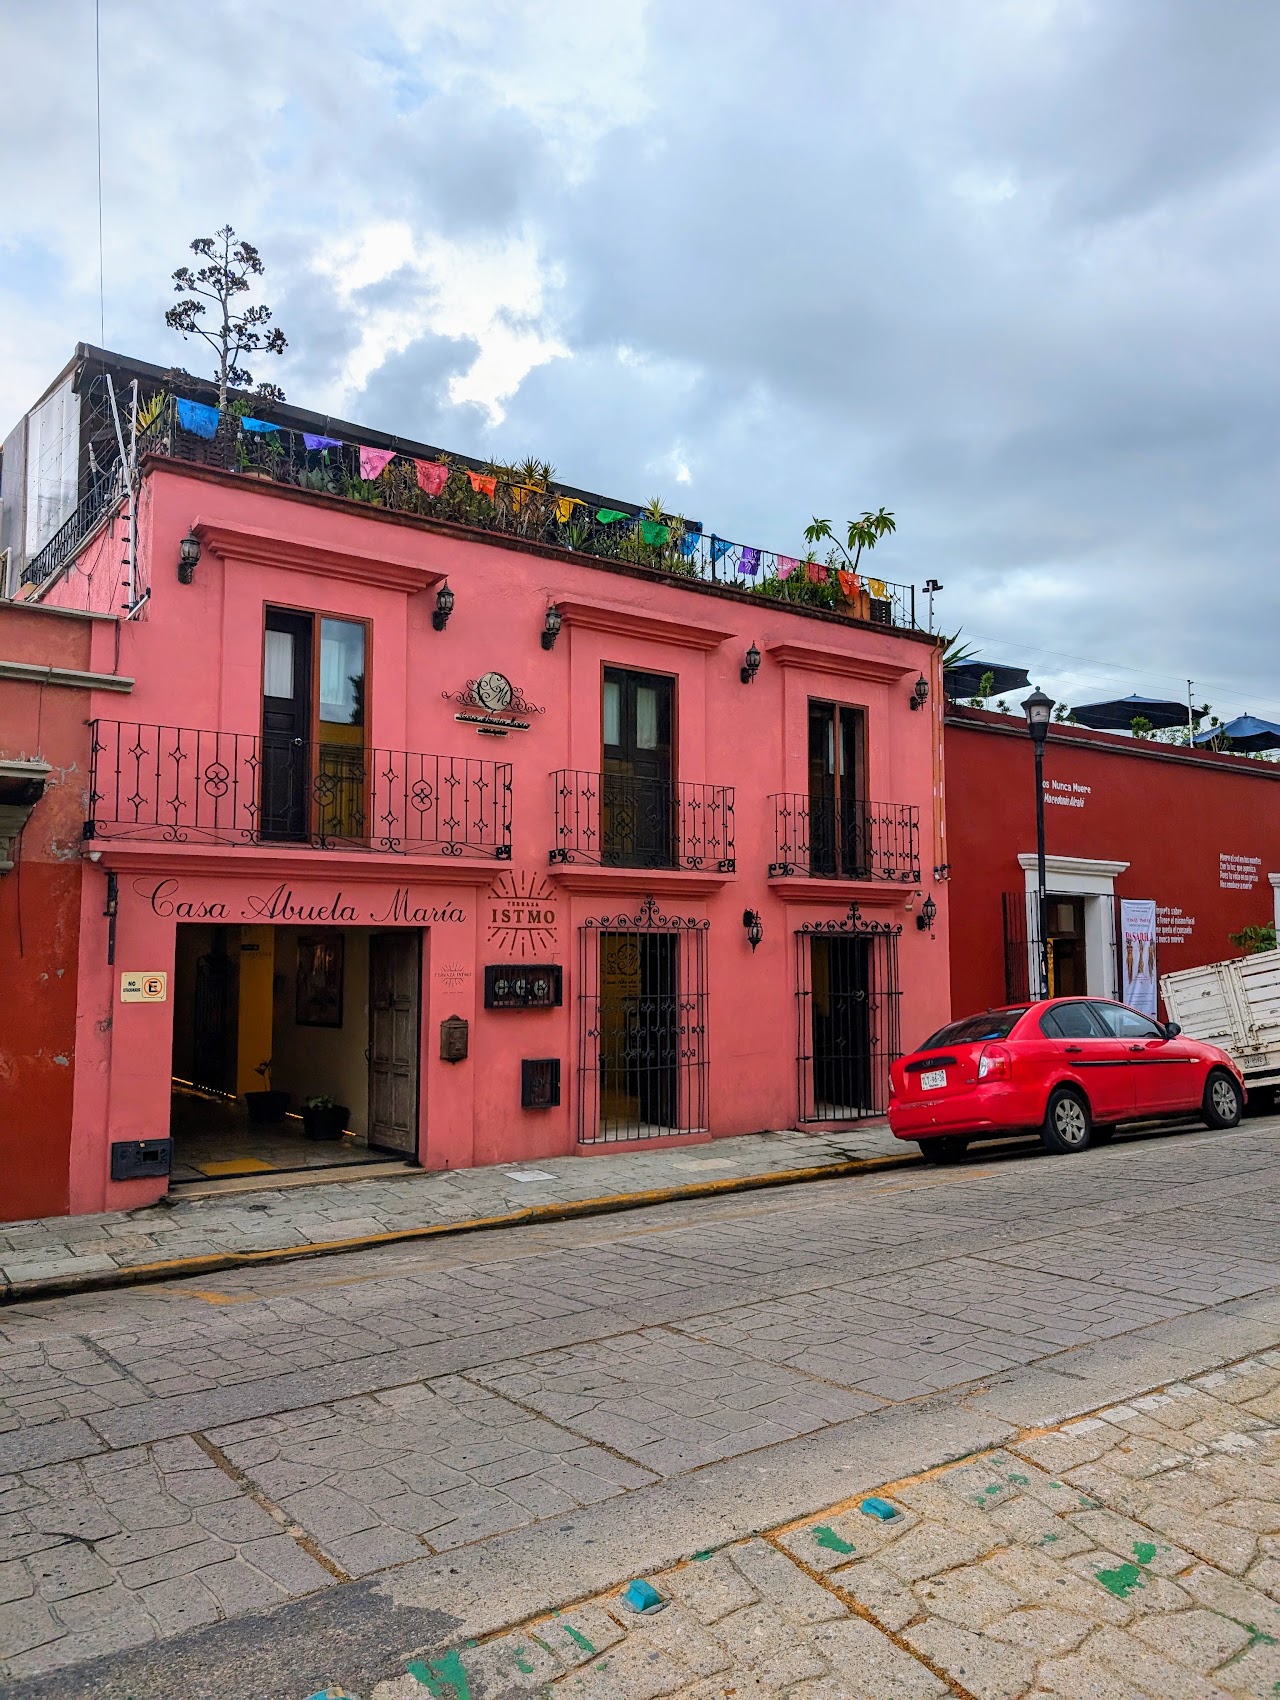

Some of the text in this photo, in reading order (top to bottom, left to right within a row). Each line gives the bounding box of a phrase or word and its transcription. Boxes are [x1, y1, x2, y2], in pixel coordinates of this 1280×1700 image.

[1052, 780, 1072, 792] Nunca
[1072, 782, 1092, 794] Muere
[132, 877, 467, 923] Casa Abuela María
[492, 908, 555, 924] ISTMO
